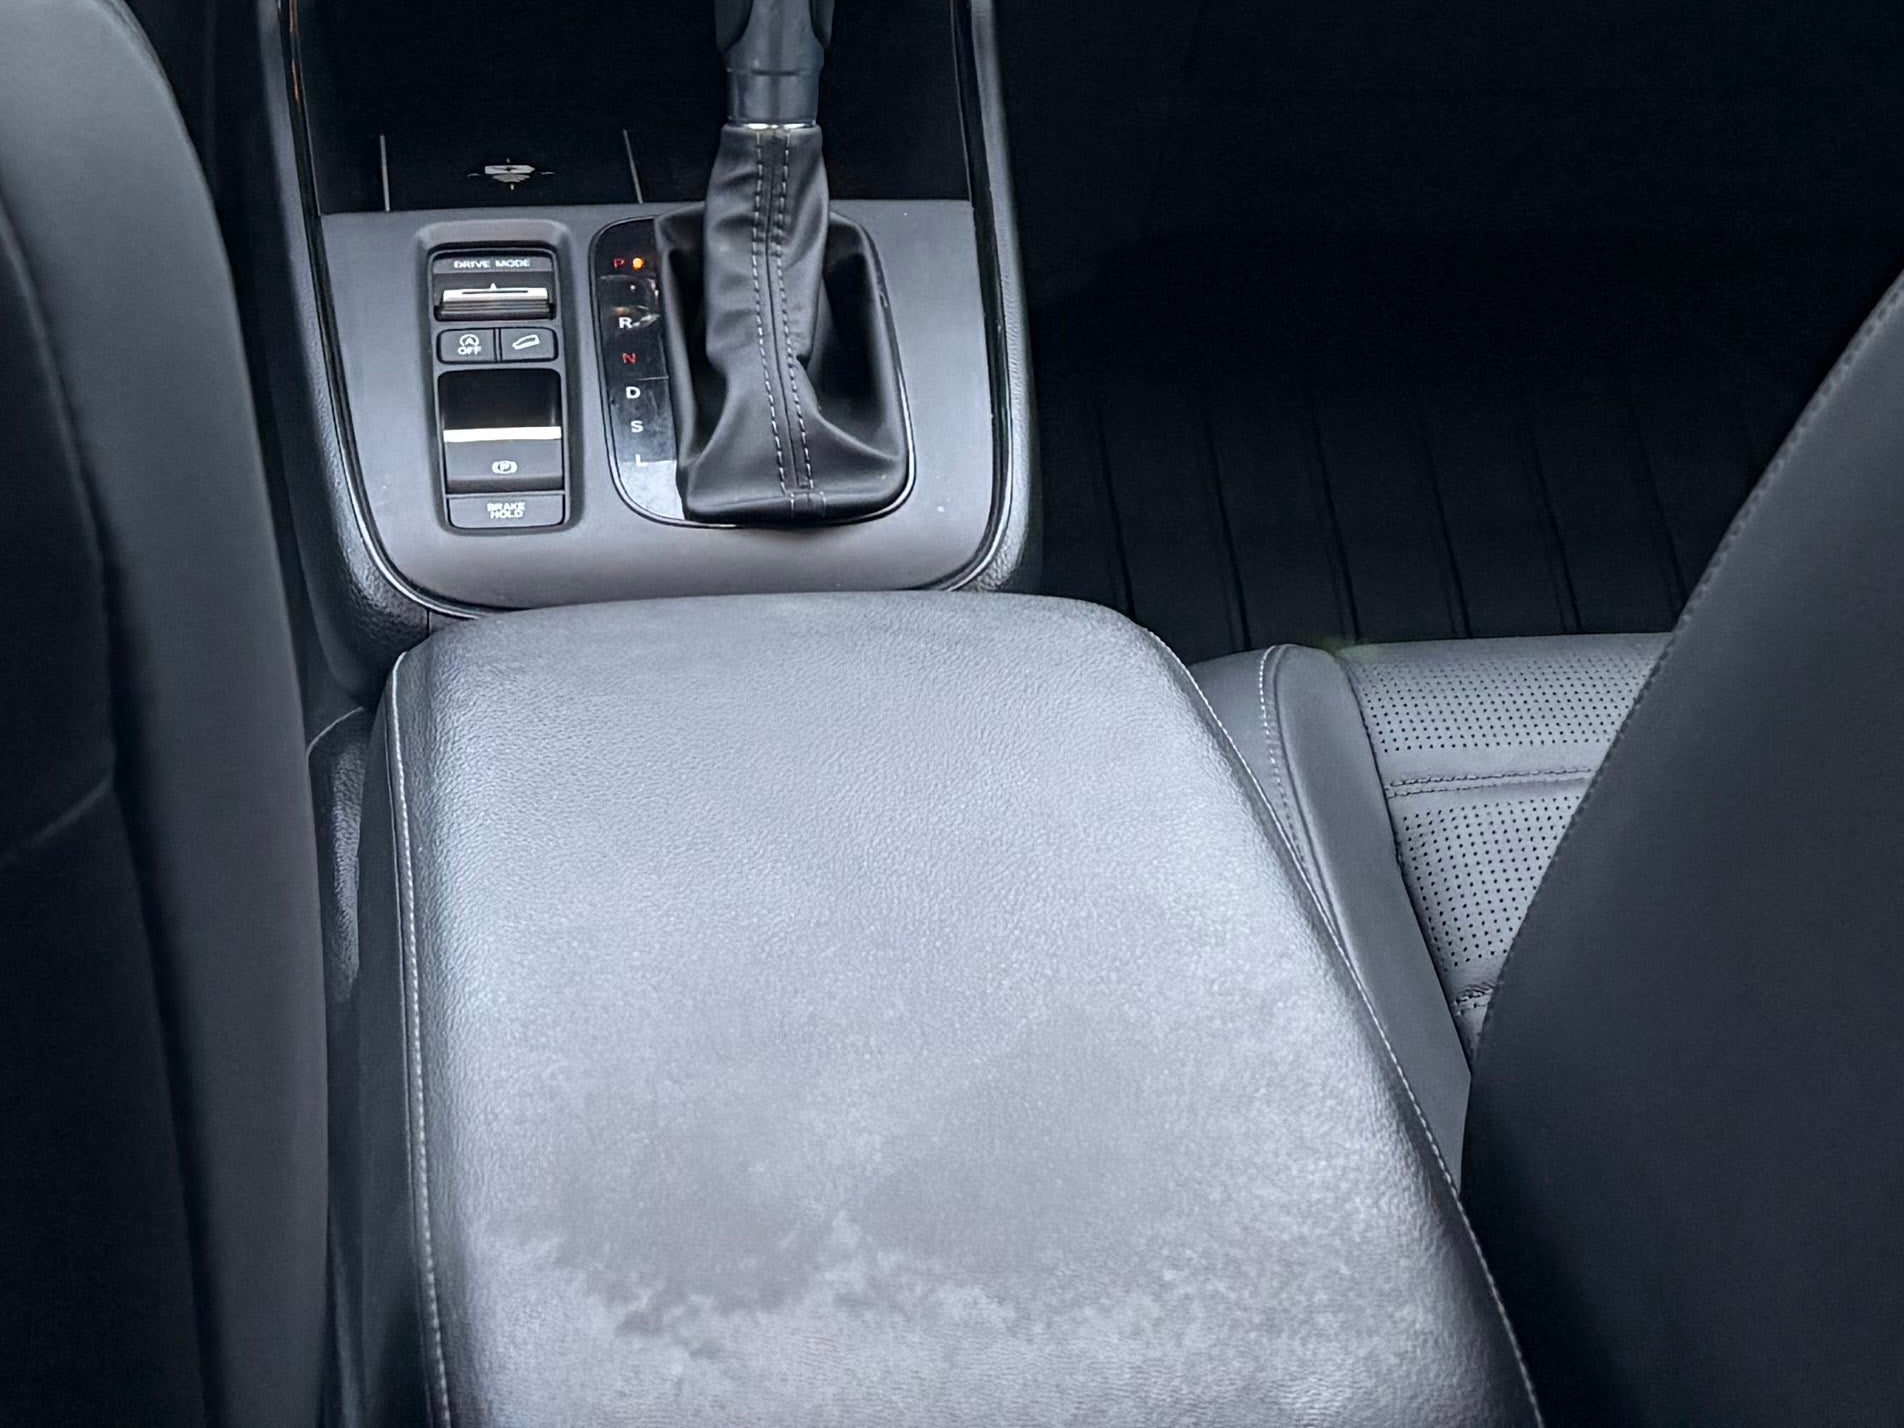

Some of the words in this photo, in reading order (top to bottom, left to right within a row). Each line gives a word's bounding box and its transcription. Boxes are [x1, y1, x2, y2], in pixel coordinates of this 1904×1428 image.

[453, 259, 490, 269] DRIVE
[495, 258, 530, 268] MODE
[613, 258, 625, 269] P
[619, 316, 633, 329] R
[457, 345, 483, 356] OFF
[621, 352, 639, 365] N
[625, 386, 641, 399] D
[630, 420, 644, 433] S
[634, 453, 647, 468] L
[487, 501, 526, 512] BRAKE
[489, 510, 524, 520] HOLD
